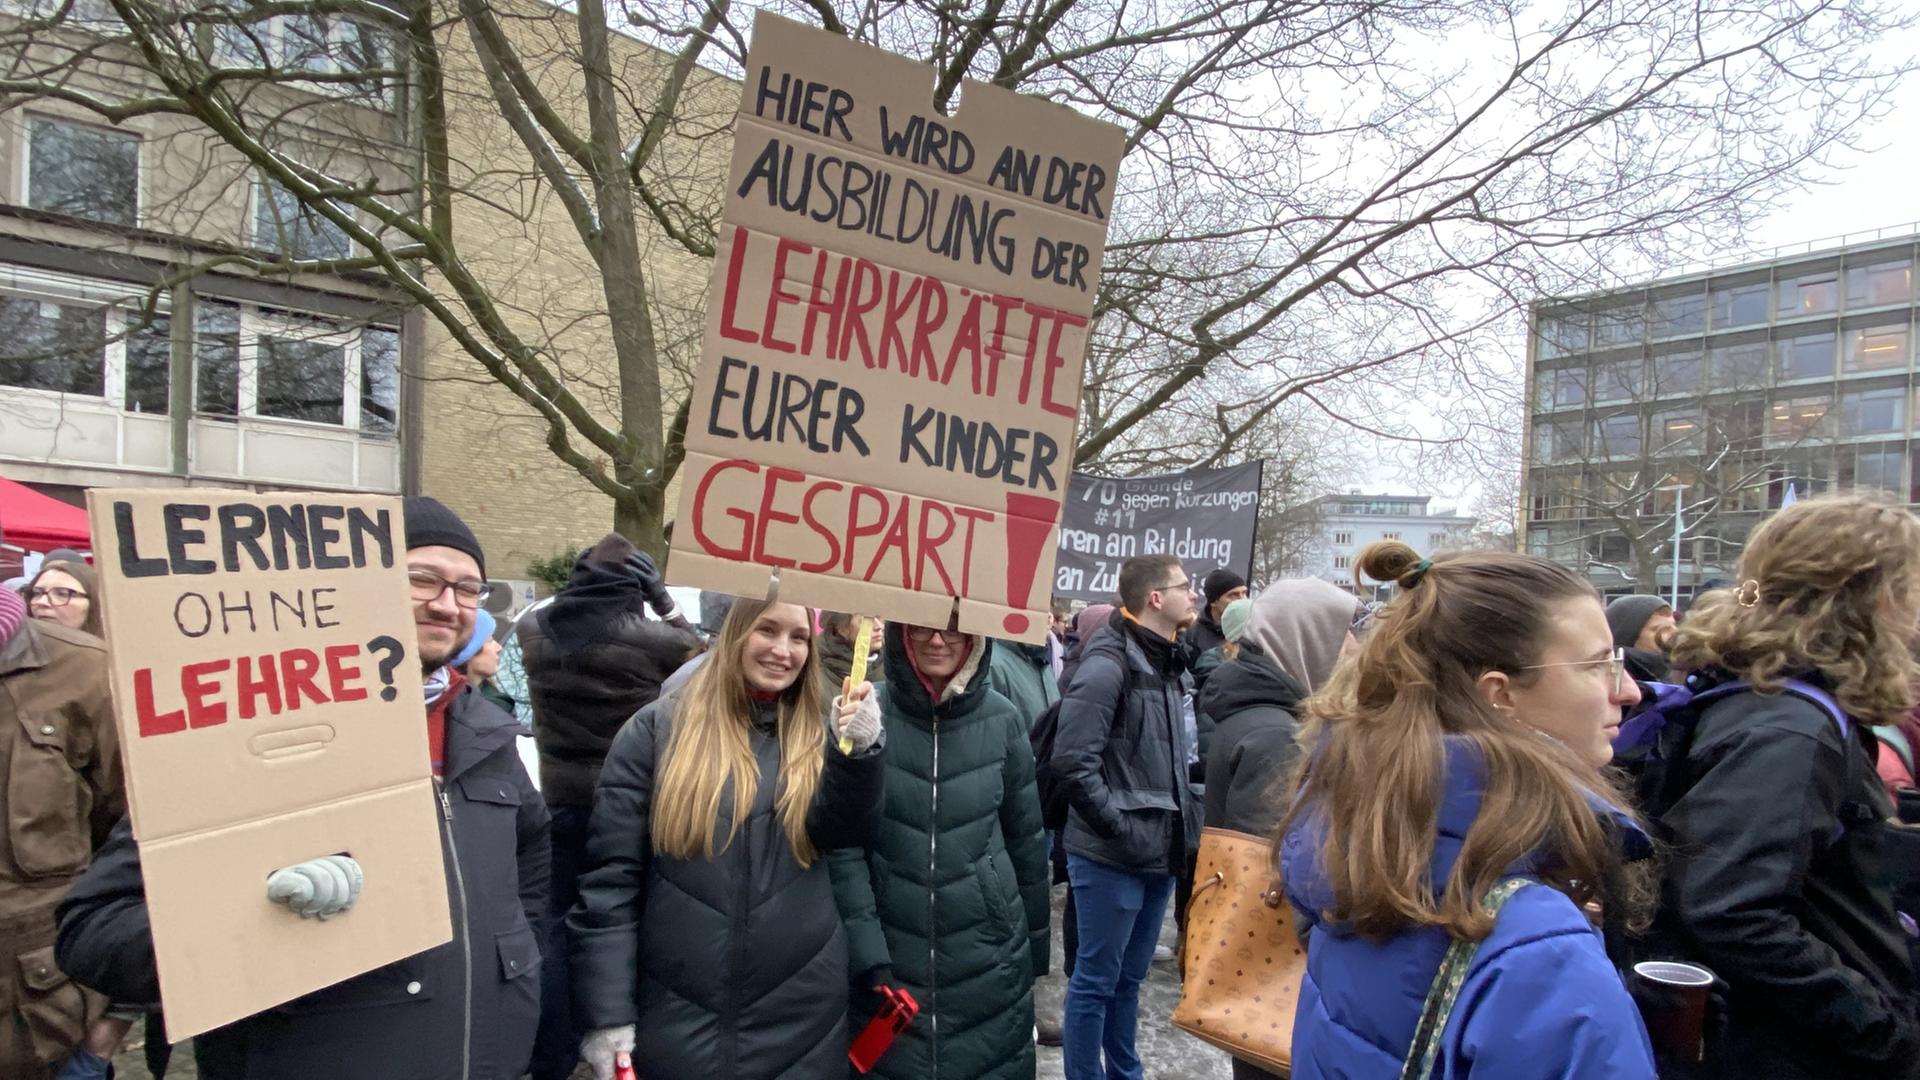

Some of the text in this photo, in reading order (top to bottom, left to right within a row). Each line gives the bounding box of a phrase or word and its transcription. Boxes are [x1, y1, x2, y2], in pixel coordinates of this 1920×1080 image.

[756, 65, 1107, 220] HIER WIRD AN DER
[736, 138, 1090, 292] AUSBILDUNG DER
[720, 225, 1090, 418] LEHRKRÄFTE
[708, 355, 1061, 492] EURER KINDER
[1082, 477, 1194, 506] 70 Gründe
[1094, 508, 1136, 529] #11
[1122, 489, 1258, 512] gegen Kürzungen
[113, 501, 394, 578] LERNEN
[1057, 527, 1232, 567] ren an Bildung
[1057, 566, 1084, 592] an
[174, 588, 340, 638] OHNE
[134, 635, 405, 738] LEHRE?
